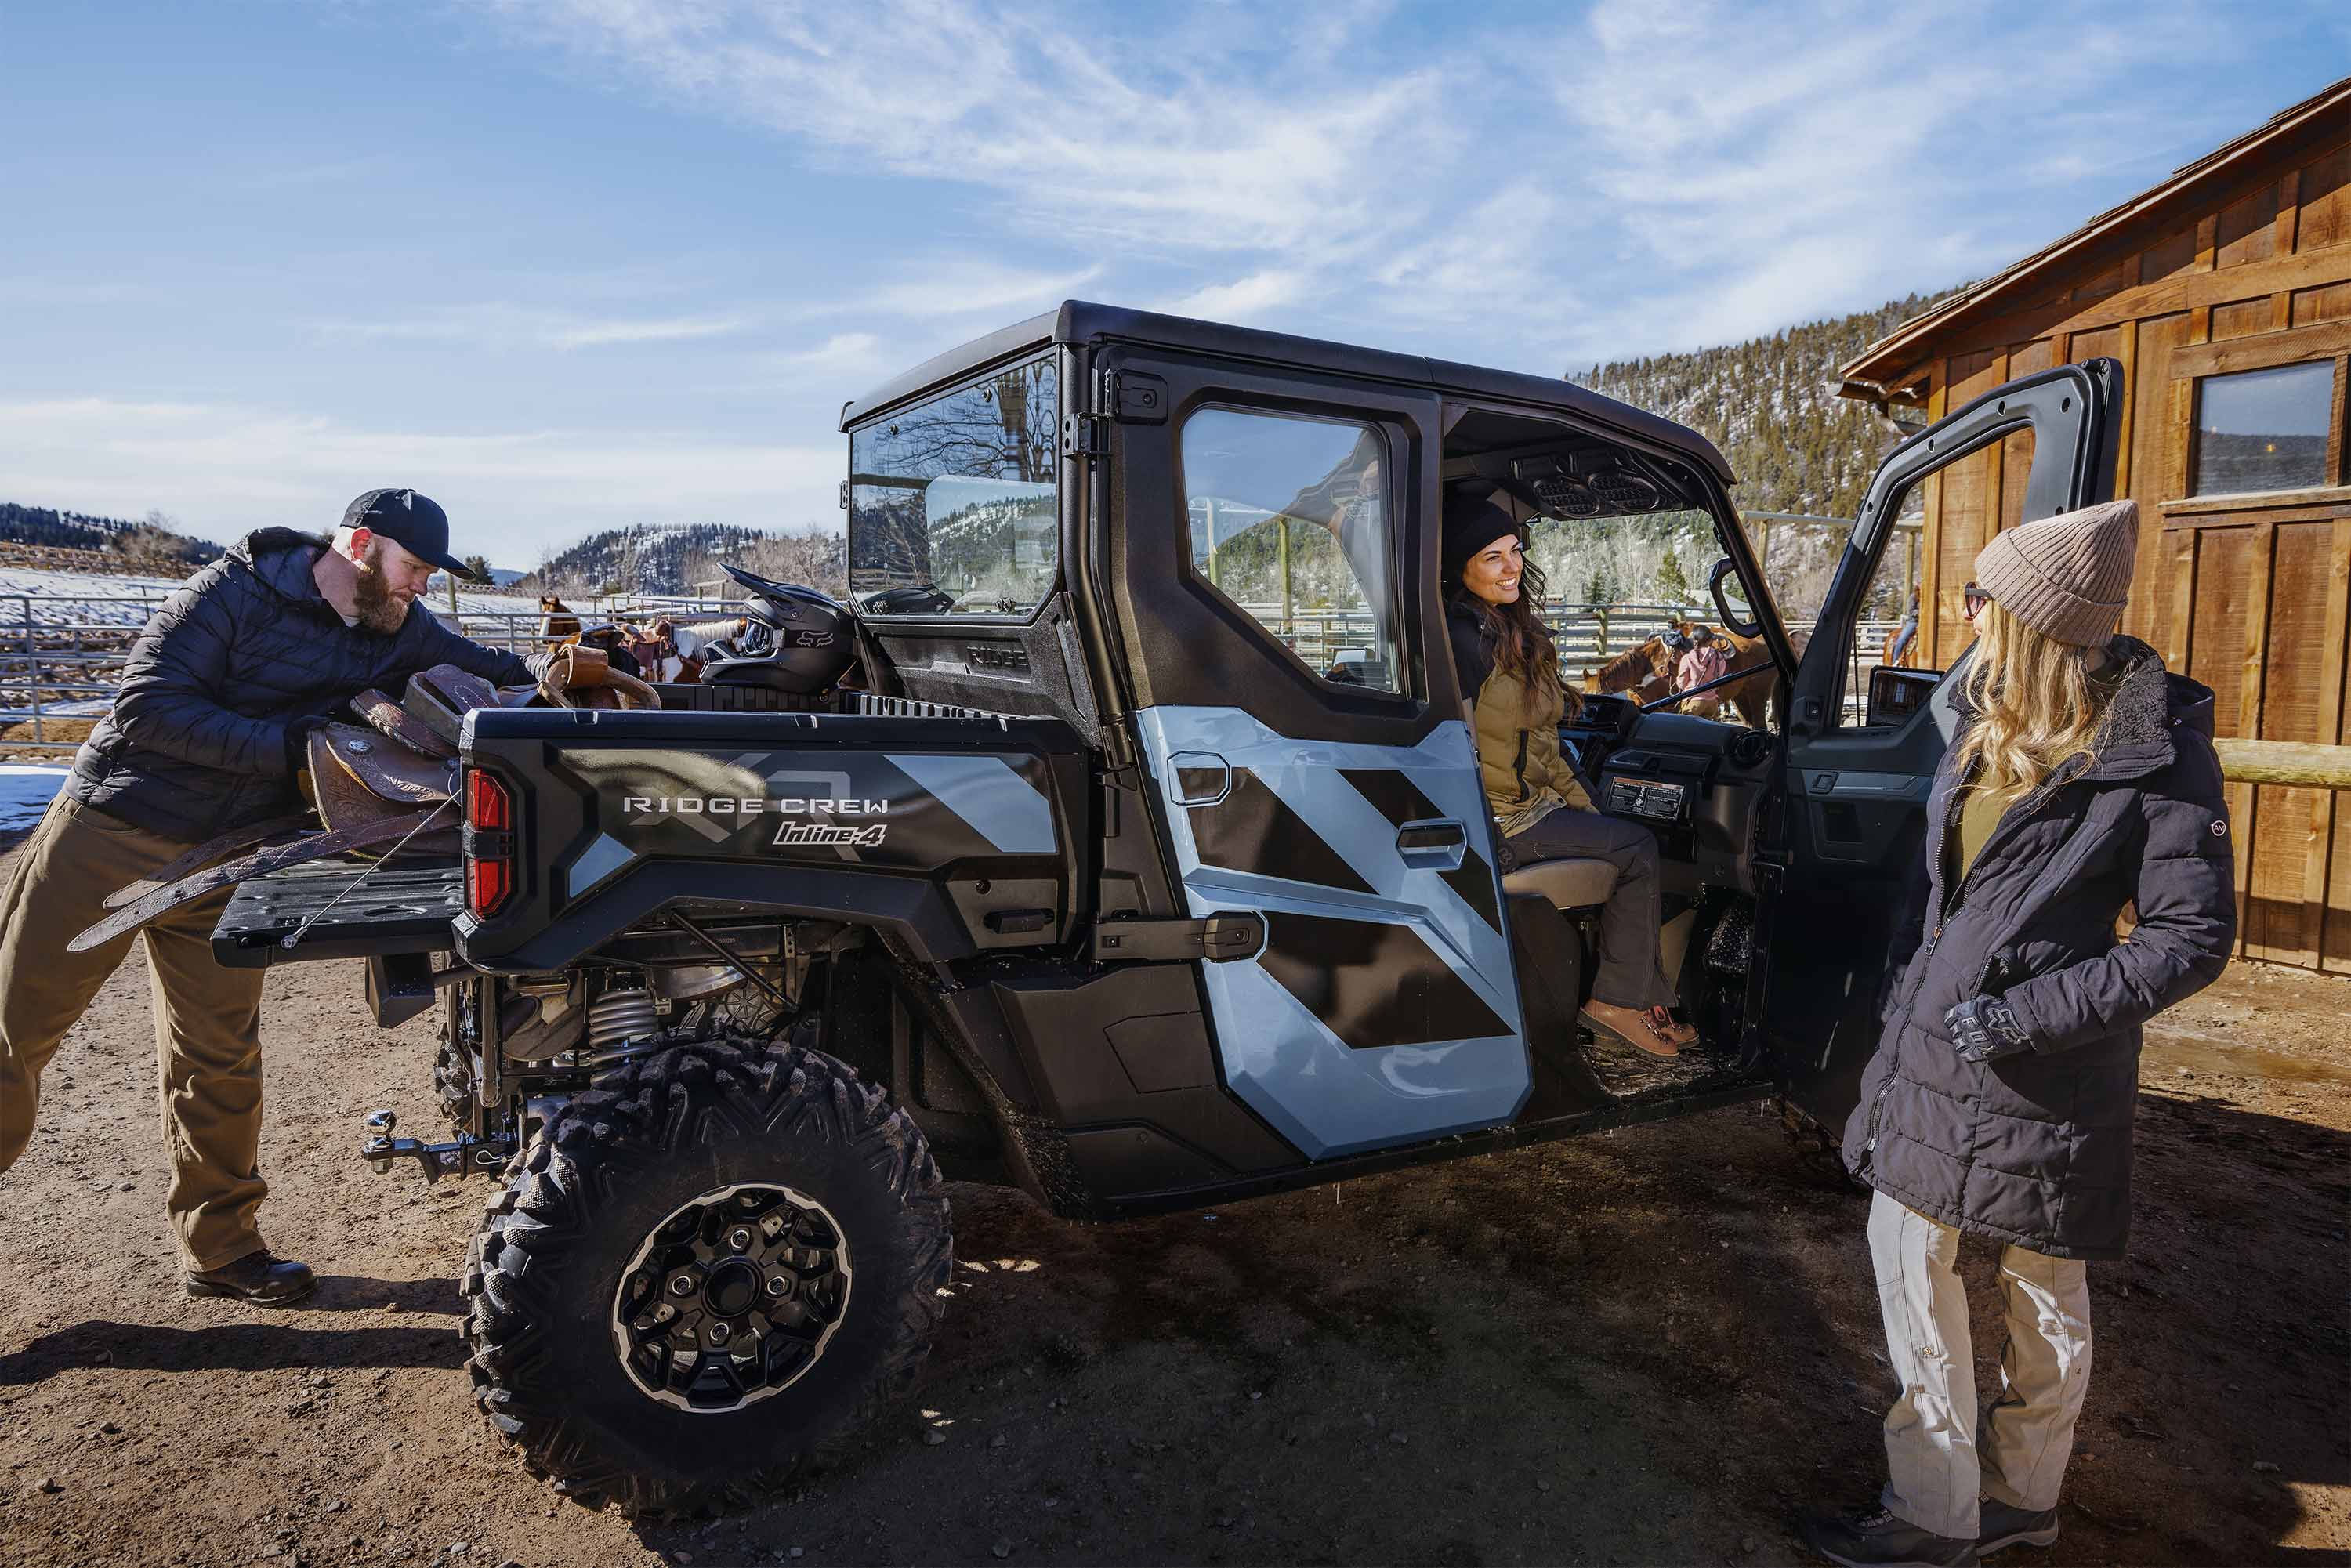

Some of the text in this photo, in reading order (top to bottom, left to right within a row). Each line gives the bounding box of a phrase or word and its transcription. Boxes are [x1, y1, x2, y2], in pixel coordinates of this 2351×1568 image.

[966, 646, 1029, 668] RIDGE
[623, 796, 888, 814] RIDGE CREW
[772, 820, 888, 847] Inline-4
